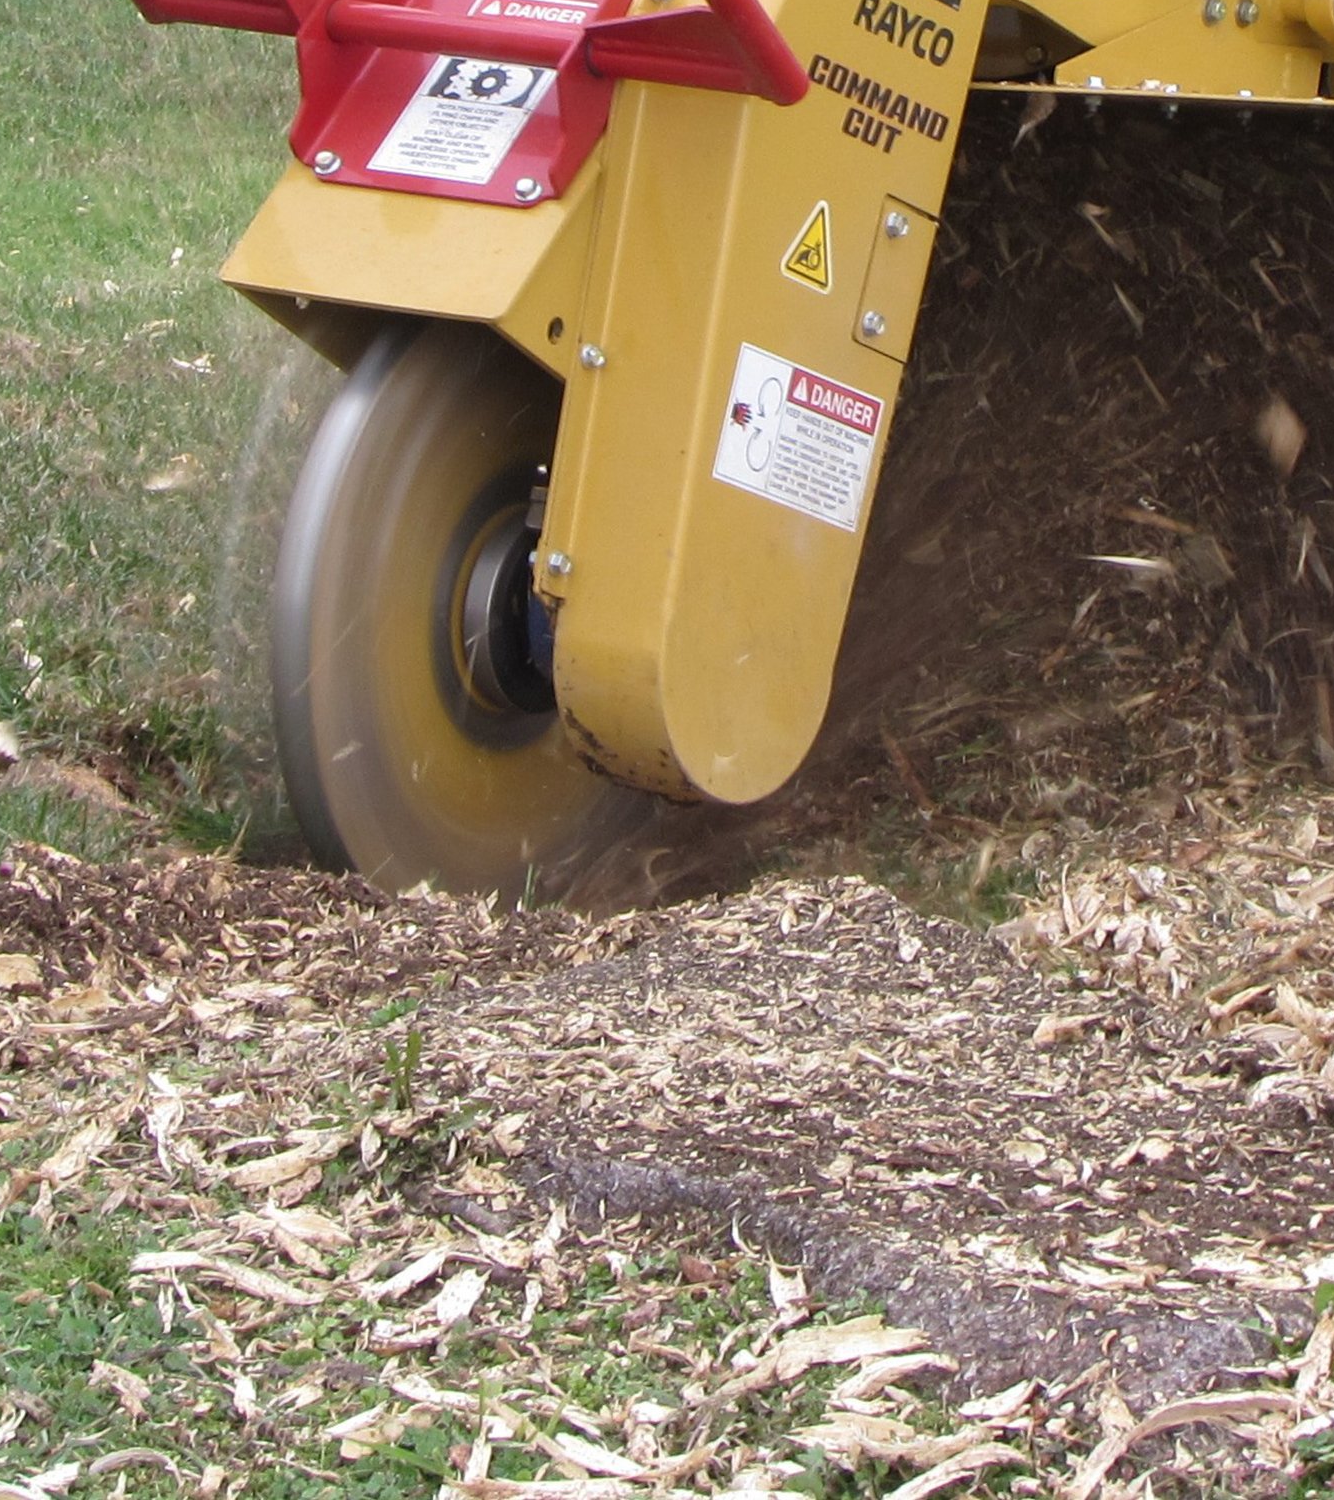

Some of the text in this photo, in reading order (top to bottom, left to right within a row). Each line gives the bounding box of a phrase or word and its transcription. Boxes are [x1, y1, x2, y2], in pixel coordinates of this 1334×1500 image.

[504, 2, 587, 24] DANGER
[808, 54, 950, 142] COMMAND
[842, 107, 902, 154] CUT
[810, 384, 875, 430] DANGER
